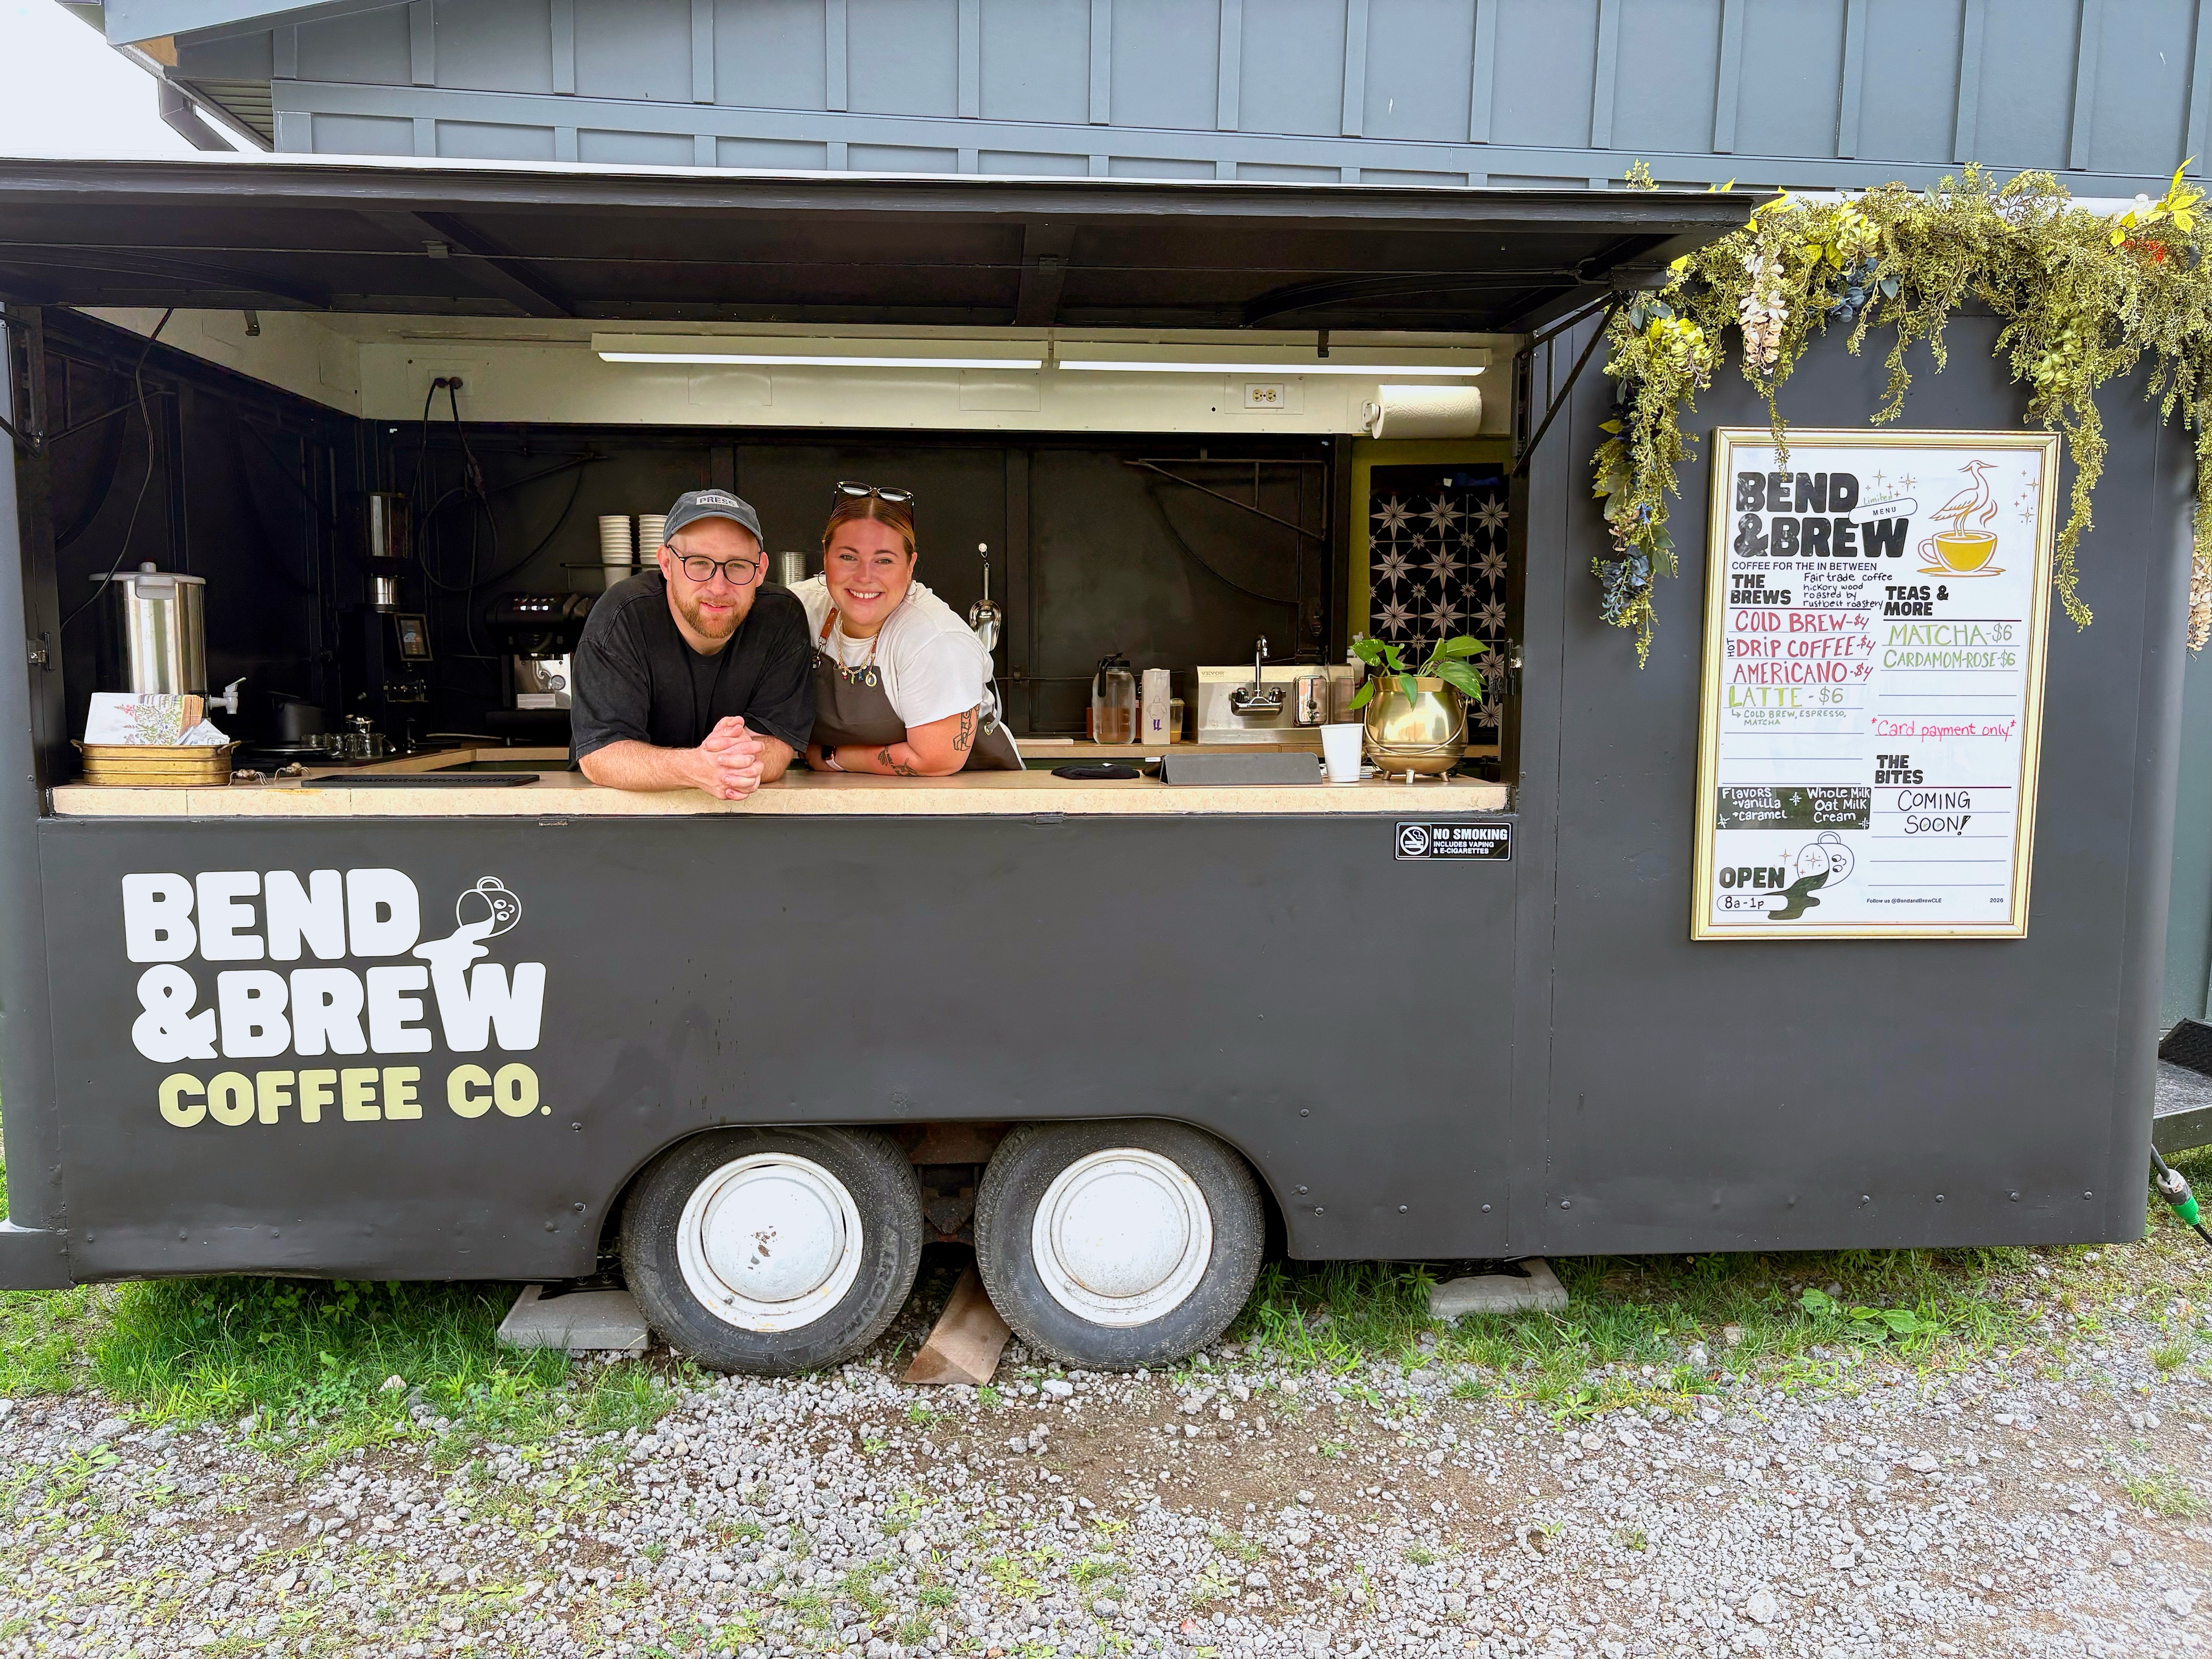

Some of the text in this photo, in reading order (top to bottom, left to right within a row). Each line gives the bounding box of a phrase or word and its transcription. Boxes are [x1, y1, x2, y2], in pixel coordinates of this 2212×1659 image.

[1736, 472, 1859, 513] BEND
[1864, 491, 1892, 505] Limited
[700, 497, 735, 506] PRESS
[1873, 507, 1896, 515] MENU
[1734, 513, 1909, 558] &BREW
[1732, 562, 1770, 570] COFFEE
[1773, 562, 1792, 570] FOR
[1732, 574, 1765, 588] THE
[1804, 572, 1893, 583] Fair trade coffee
[1730, 590, 1791, 605] BREWS
[1847, 592, 1857, 600] by
[1885, 585, 1949, 600] TEAS &
[1847, 600, 1883, 610] roastery
[1883, 601, 1933, 616] MORE
[1729, 685, 1803, 708] LATTE
[1819, 686, 1843, 705] $6
[1744, 710, 1765, 718] COLD
[1769, 710, 1798, 719] BREW,
[1922, 723, 1975, 743] payment
[1876, 755, 1909, 768] THE
[1875, 769, 1923, 784] BITES
[1806, 788, 1870, 799] Whole Milk
[1898, 790, 1971, 811] COMING
[1738, 798, 1781, 809] vanilla
[1814, 798, 1839, 811] Oat
[1738, 809, 1787, 821] caramel
[1814, 812, 1856, 823] Cream
[1904, 815, 1971, 836] SOON!
[1433, 828, 1508, 840] NO SMOKING
[1719, 867, 1785, 888] OPEN
[121, 868, 421, 963] BEND
[131, 961, 547, 1064] &BREW
[158, 1062, 551, 1128] COFFEE CO.
